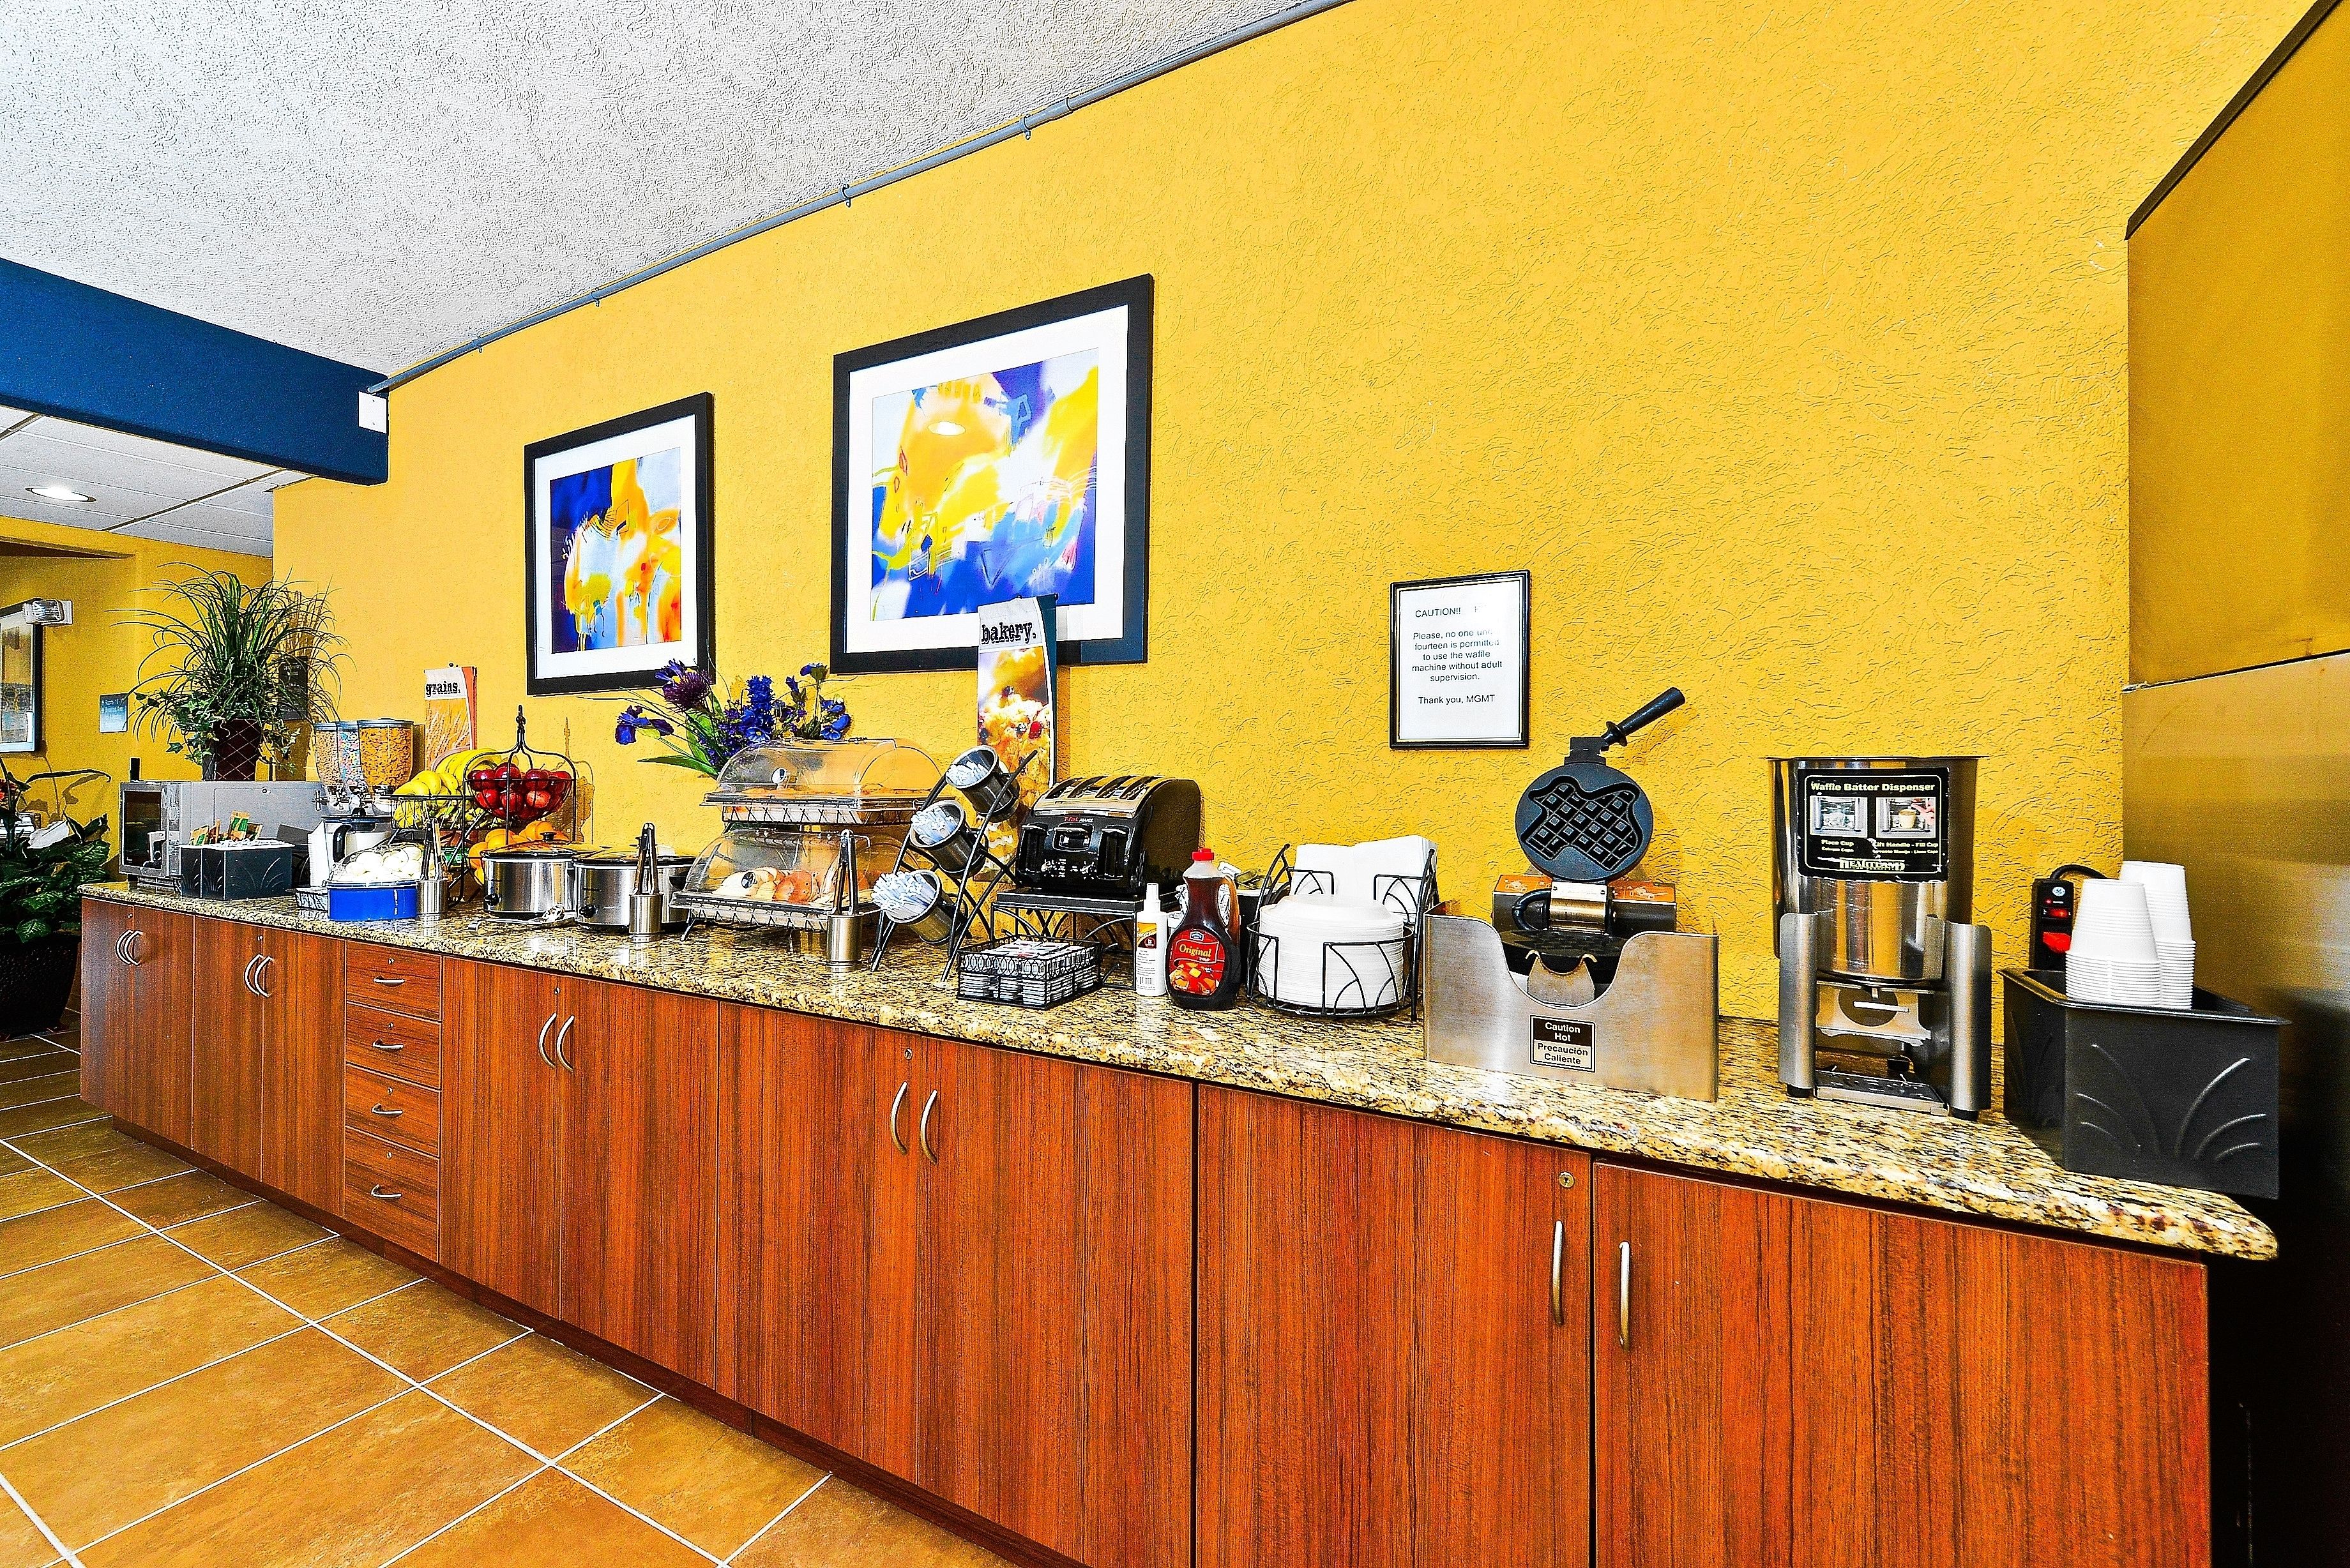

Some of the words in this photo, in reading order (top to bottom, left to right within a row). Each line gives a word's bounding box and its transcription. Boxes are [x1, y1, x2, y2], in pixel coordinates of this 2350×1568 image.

[1415, 607, 1461, 617] CAUTION!!
[981, 622, 1036, 644] bakery.
[1465, 650, 1490, 658] waffle
[1448, 661, 1479, 670] without
[1481, 660, 1503, 668] adult
[1430, 672, 1480, 682] supervision.
[425, 681, 461, 698] grains.
[1418, 696, 1444, 704] Thank
[1446, 697, 1463, 705] you,
[1466, 694, 1496, 703] MGMT
[1811, 783, 1842, 791] Waffle
[1881, 783, 1936, 793] Dispenser
[1179, 944, 1212, 958] Original
[1545, 1021, 1581, 1034] Caution
[1554, 1032, 1571, 1042] Hot
[1537, 1043, 1588, 1056] Precaución
[1544, 1053, 1581, 1064] Caliente
